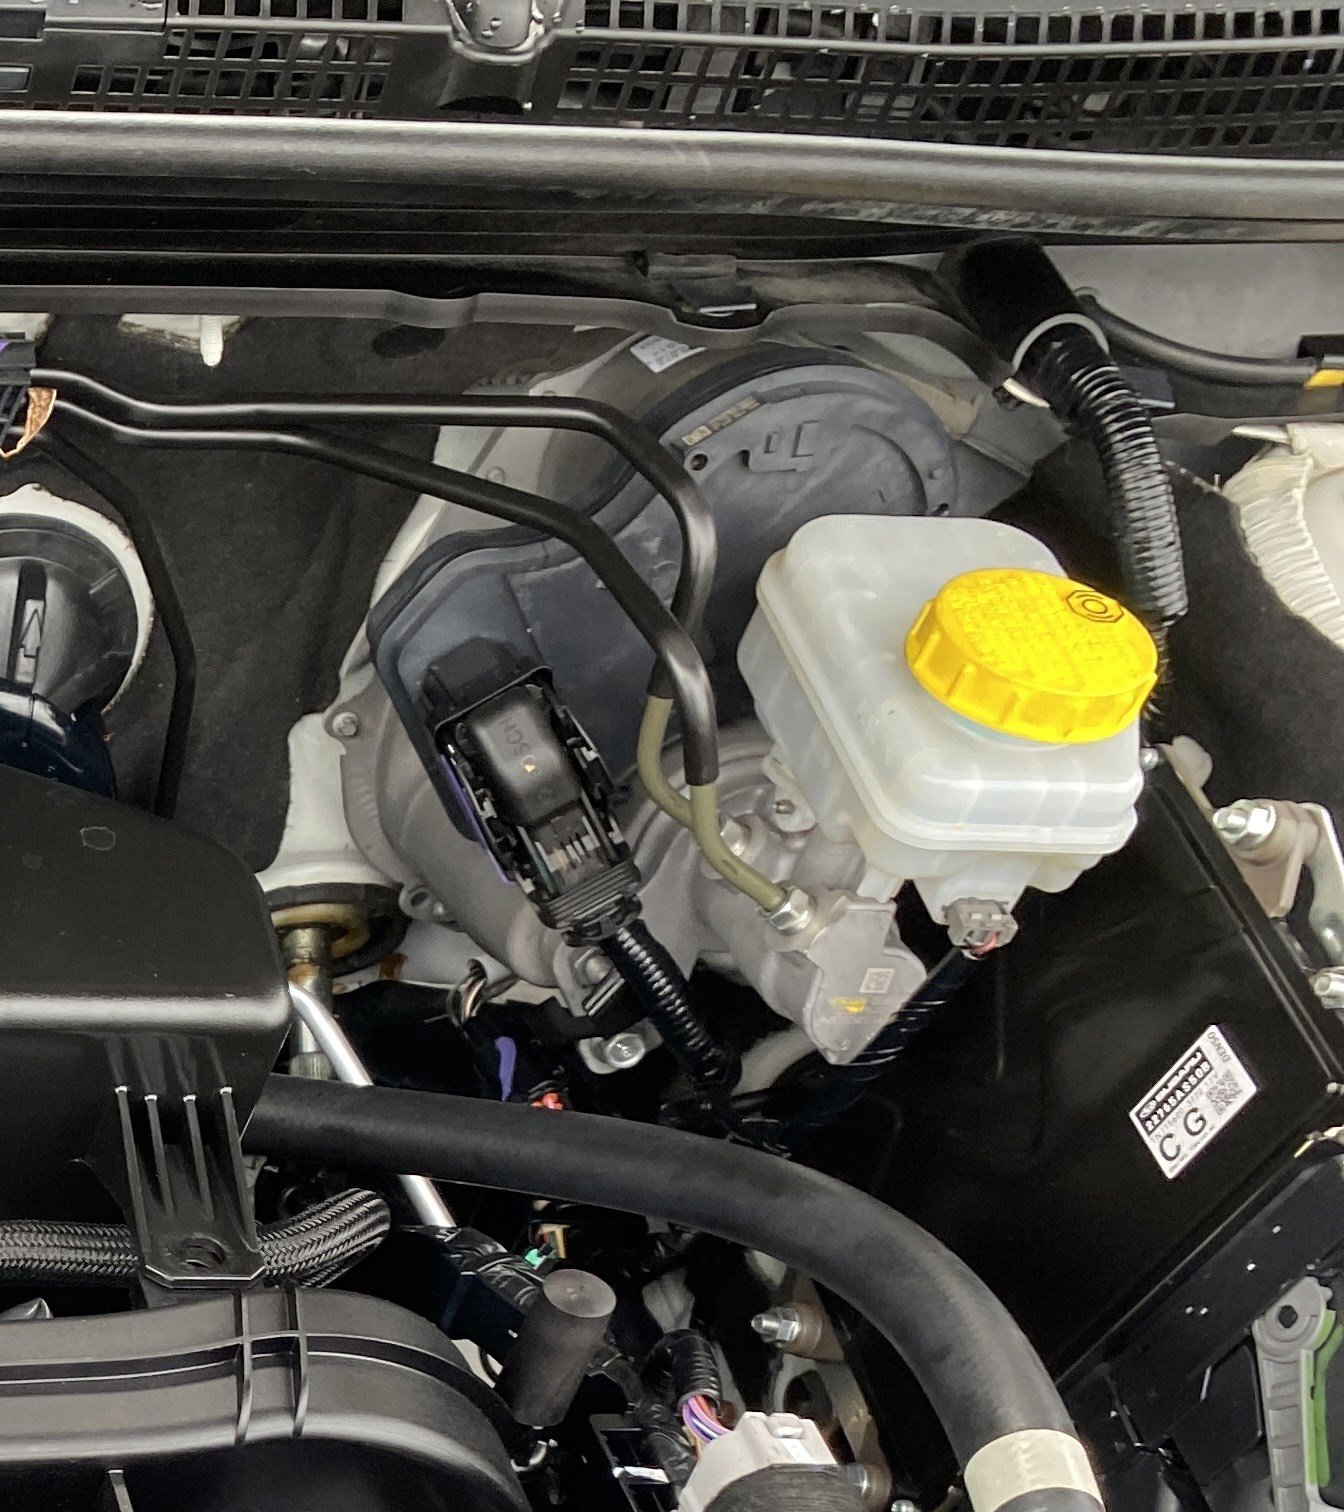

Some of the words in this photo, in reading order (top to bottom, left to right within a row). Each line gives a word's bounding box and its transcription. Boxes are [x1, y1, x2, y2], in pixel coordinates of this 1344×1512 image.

[1208, 1032, 1232, 1063] DENSO
[1154, 1051, 1203, 1104] SUBARU
[1159, 1133, 1182, 1162] C
[1184, 1107, 1207, 1136] G
